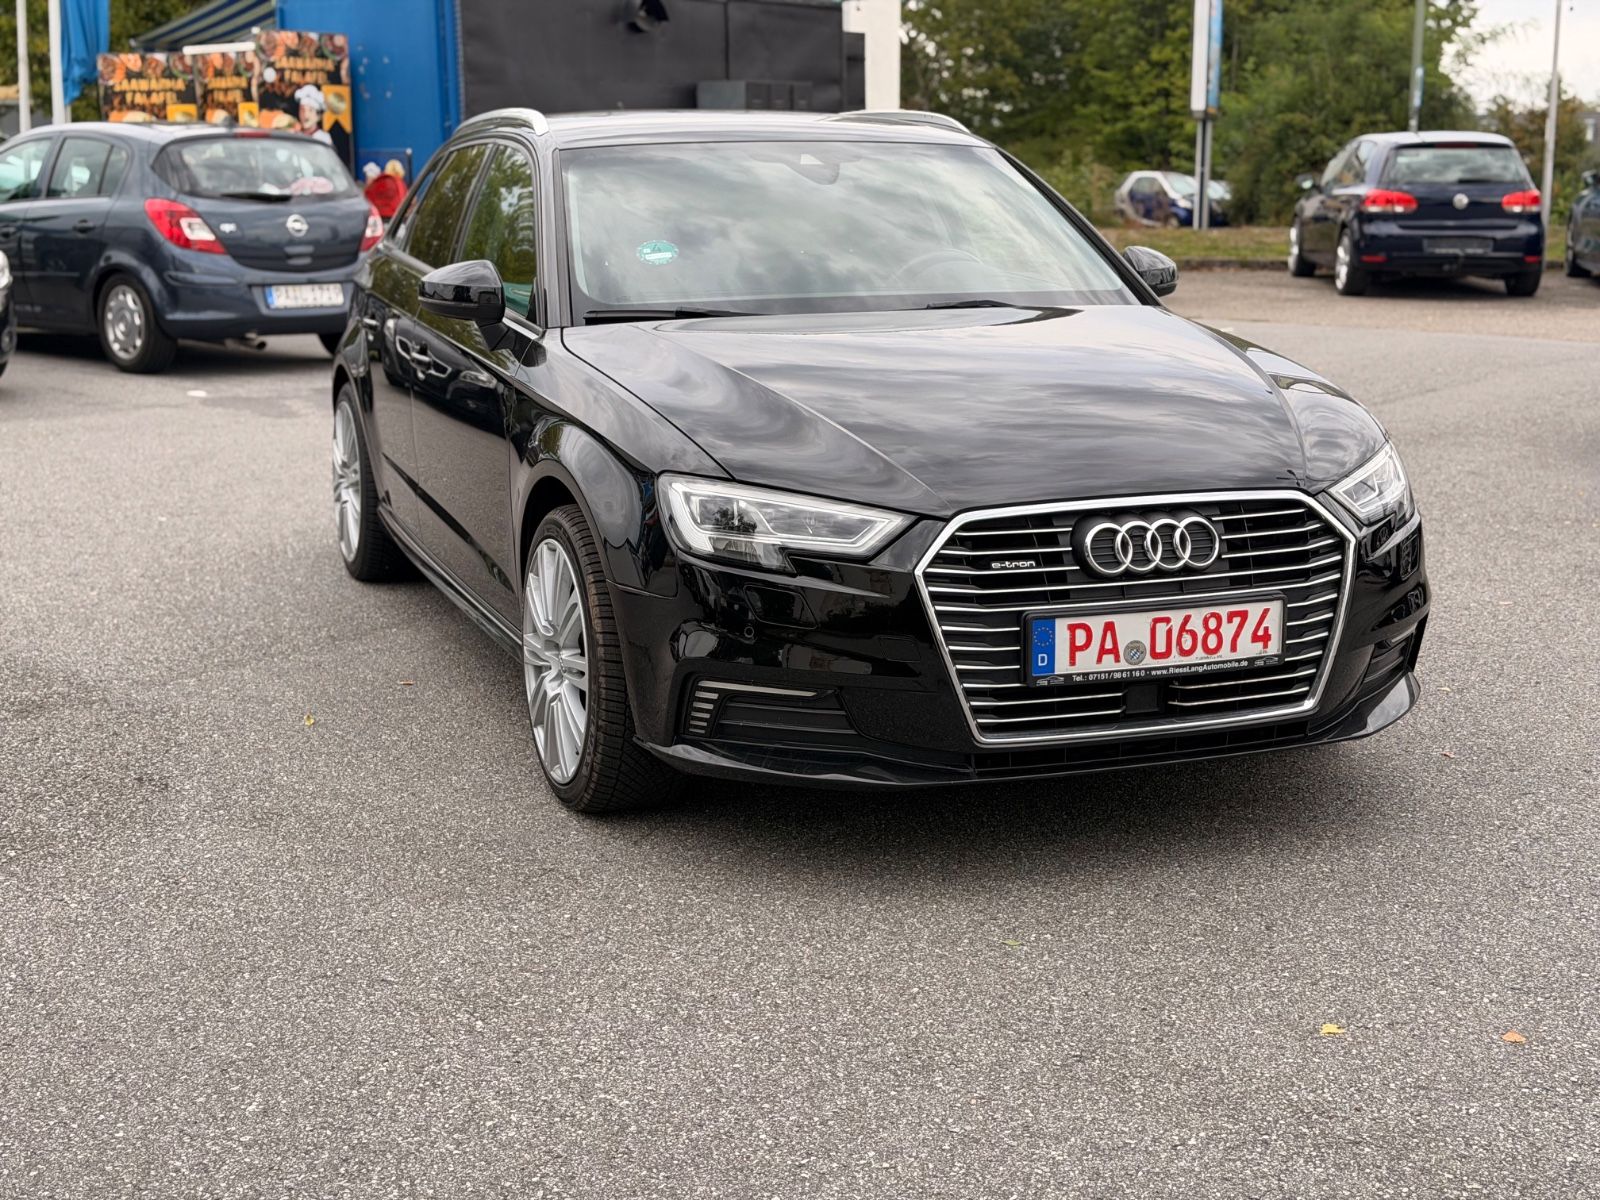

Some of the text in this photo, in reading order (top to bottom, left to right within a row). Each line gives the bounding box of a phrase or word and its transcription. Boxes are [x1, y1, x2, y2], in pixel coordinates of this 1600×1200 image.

[991, 561, 1036, 569] e-tron
[1067, 607, 1272, 667] PA 06874
[1038, 653, 1048, 666] D
[1151, 660, 1248, 676] www.RiessLangAutomobile.de
